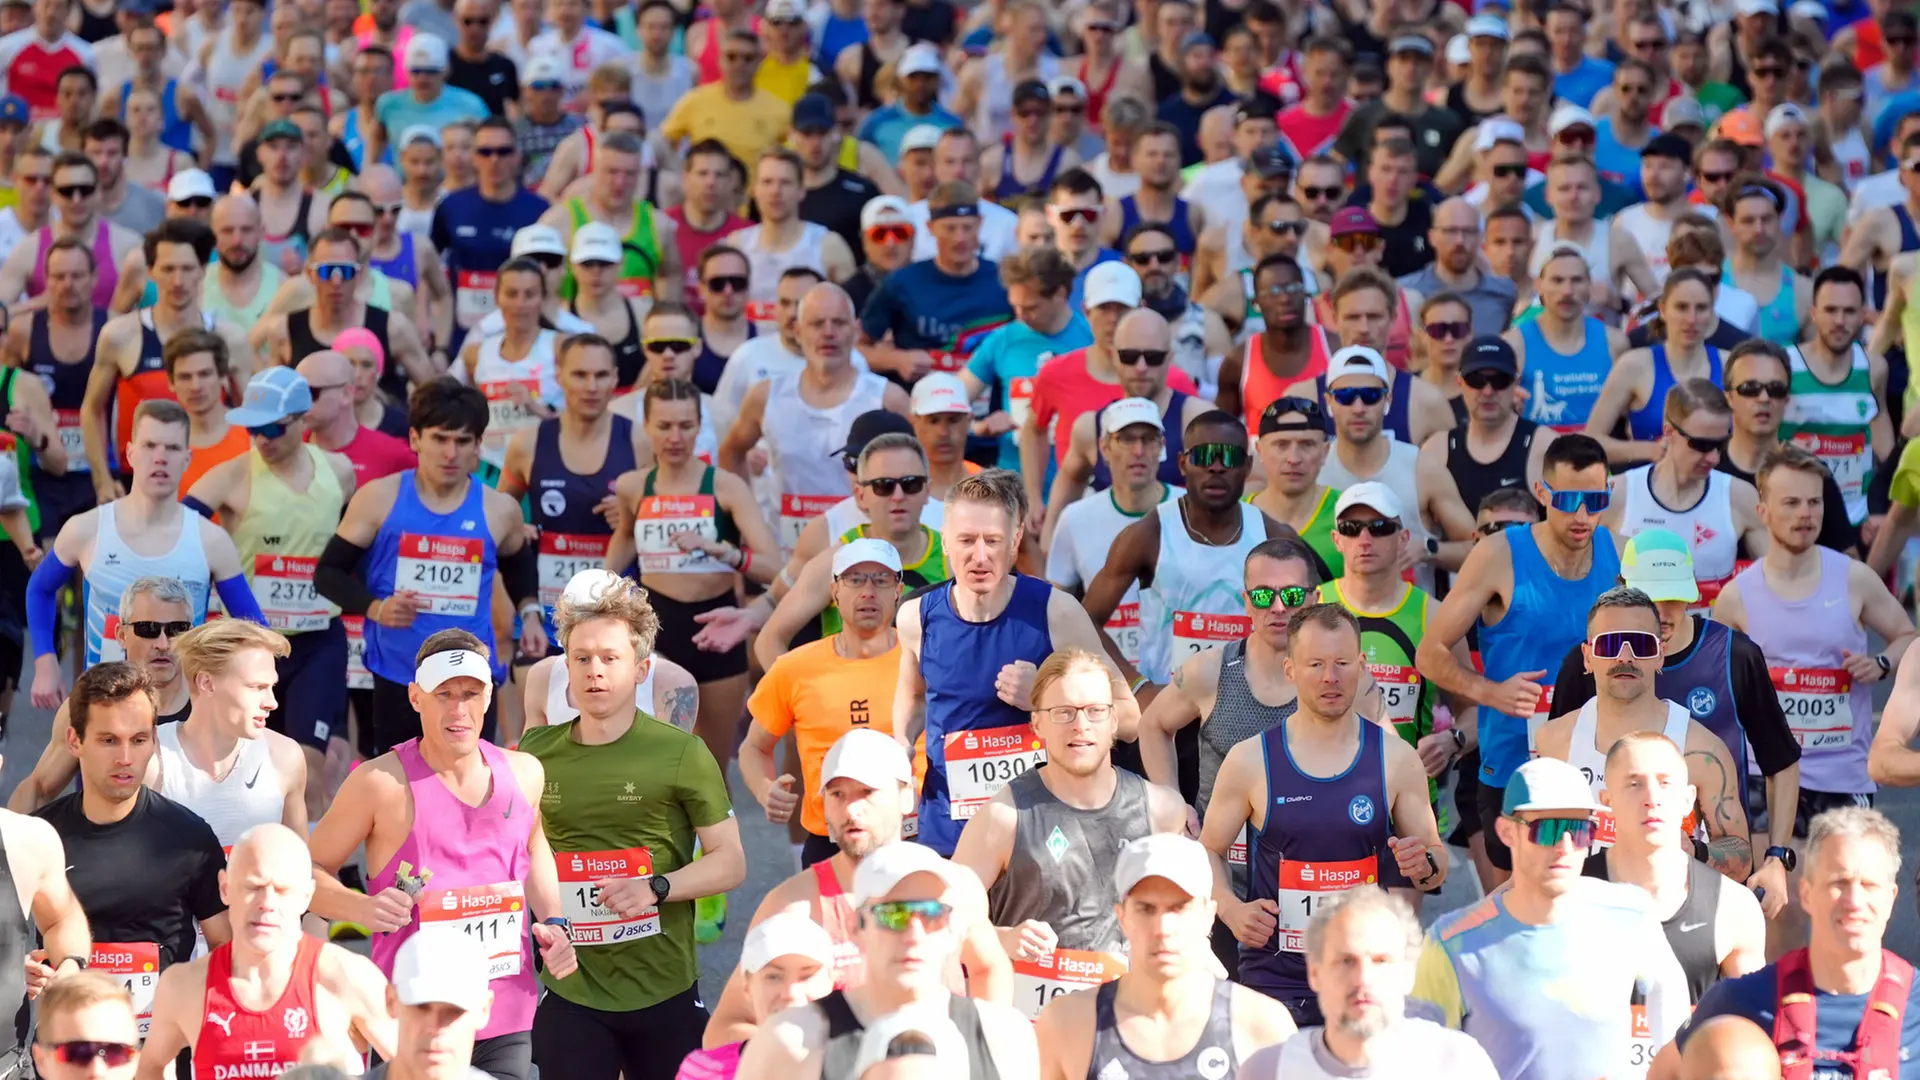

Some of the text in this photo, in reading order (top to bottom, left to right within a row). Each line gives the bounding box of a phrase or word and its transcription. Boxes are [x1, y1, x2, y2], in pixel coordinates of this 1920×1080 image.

[432, 540, 467, 556] Haspa
[413, 563, 464, 585] 2102
[270, 581, 319, 601] 2378
[1207, 619, 1245, 636] Haspa
[1800, 673, 1837, 689] Haspa
[1407, 686, 1416, 696] B
[849, 698, 870, 726] ER
[1783, 697, 1836, 717] 2003
[982, 734, 1024, 749] Haspa
[967, 752, 1042, 784] 1030 A
[1230, 849, 1248, 861] RE
[587, 858, 628, 873] Haspa
[1319, 868, 1361, 884] Haspa
[461, 894, 503, 909] Haspa
[576, 886, 604, 908] 15
[506, 914, 516, 925] A
[625, 922, 653, 937] asics
[89, 950, 134, 967] Haspa
[1057, 955, 1105, 976] Haspa
[141, 975, 152, 987] B
